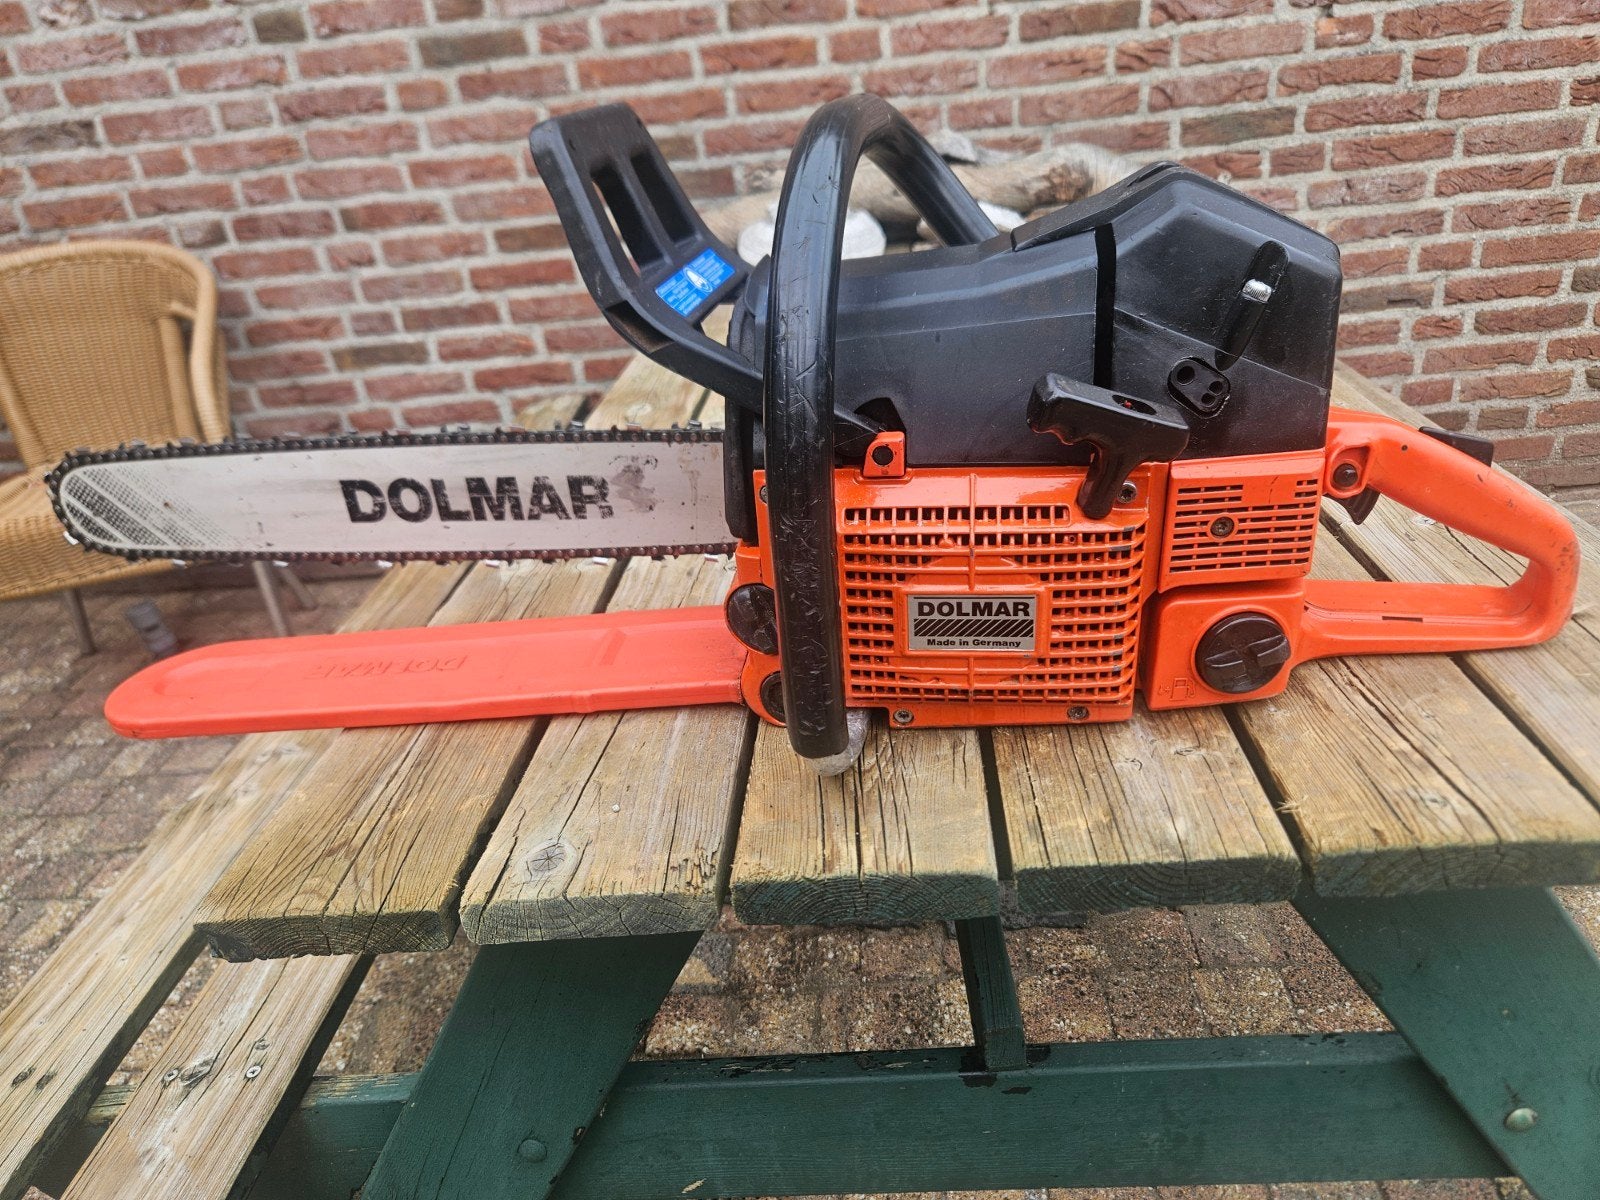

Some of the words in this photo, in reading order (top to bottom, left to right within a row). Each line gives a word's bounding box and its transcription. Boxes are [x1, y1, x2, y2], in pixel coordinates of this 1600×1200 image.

[339, 475, 614, 523] DOLMAR
[917, 601, 1030, 617] DOLMAR
[972, 639, 1021, 647] Germany
